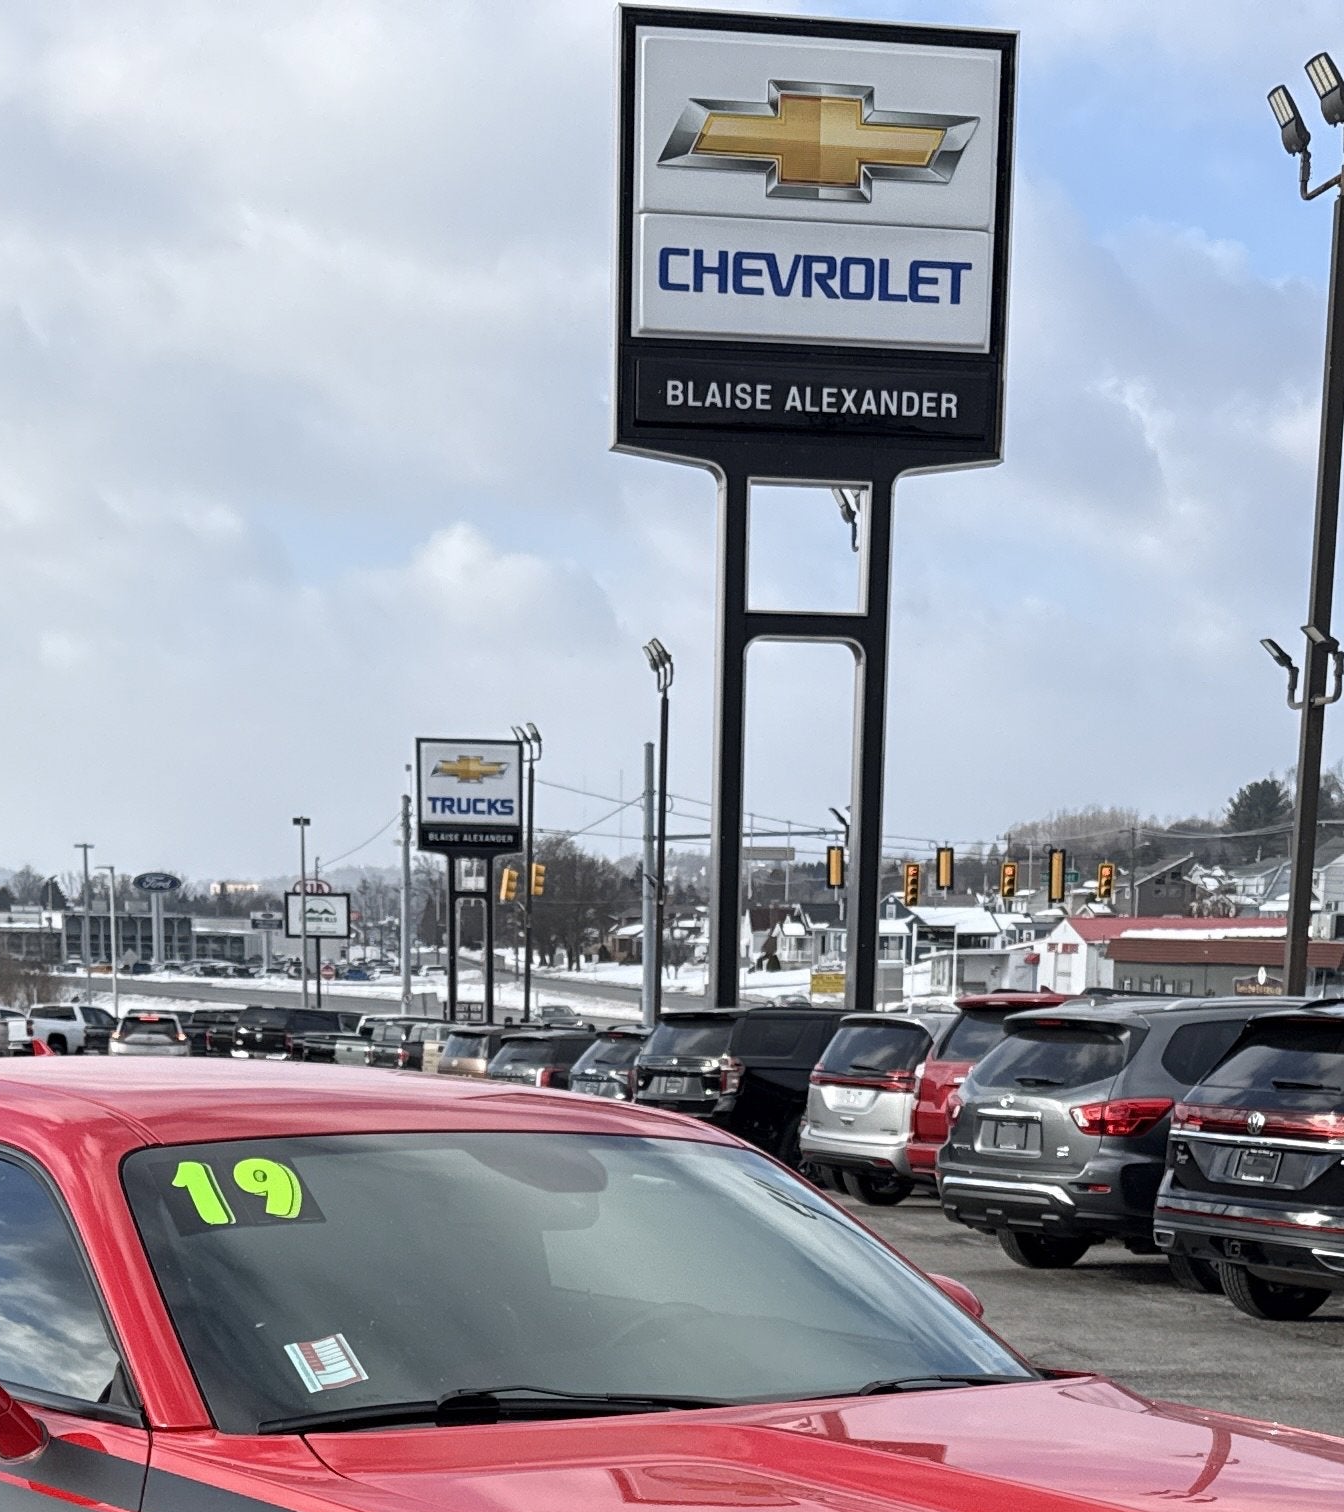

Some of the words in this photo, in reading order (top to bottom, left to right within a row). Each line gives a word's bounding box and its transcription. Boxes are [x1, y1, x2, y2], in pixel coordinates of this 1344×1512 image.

[658, 247, 972, 304] CHEVROLET
[666, 380, 772, 410] BLAISE
[784, 386, 958, 419] ALEXANDER
[427, 796, 514, 816] TRUCKS
[428, 832, 460, 842] BLAISE
[462, 833, 514, 843] ALEXANDER
[142, 877, 172, 889] Ford
[171, 1157, 303, 1226] 19
